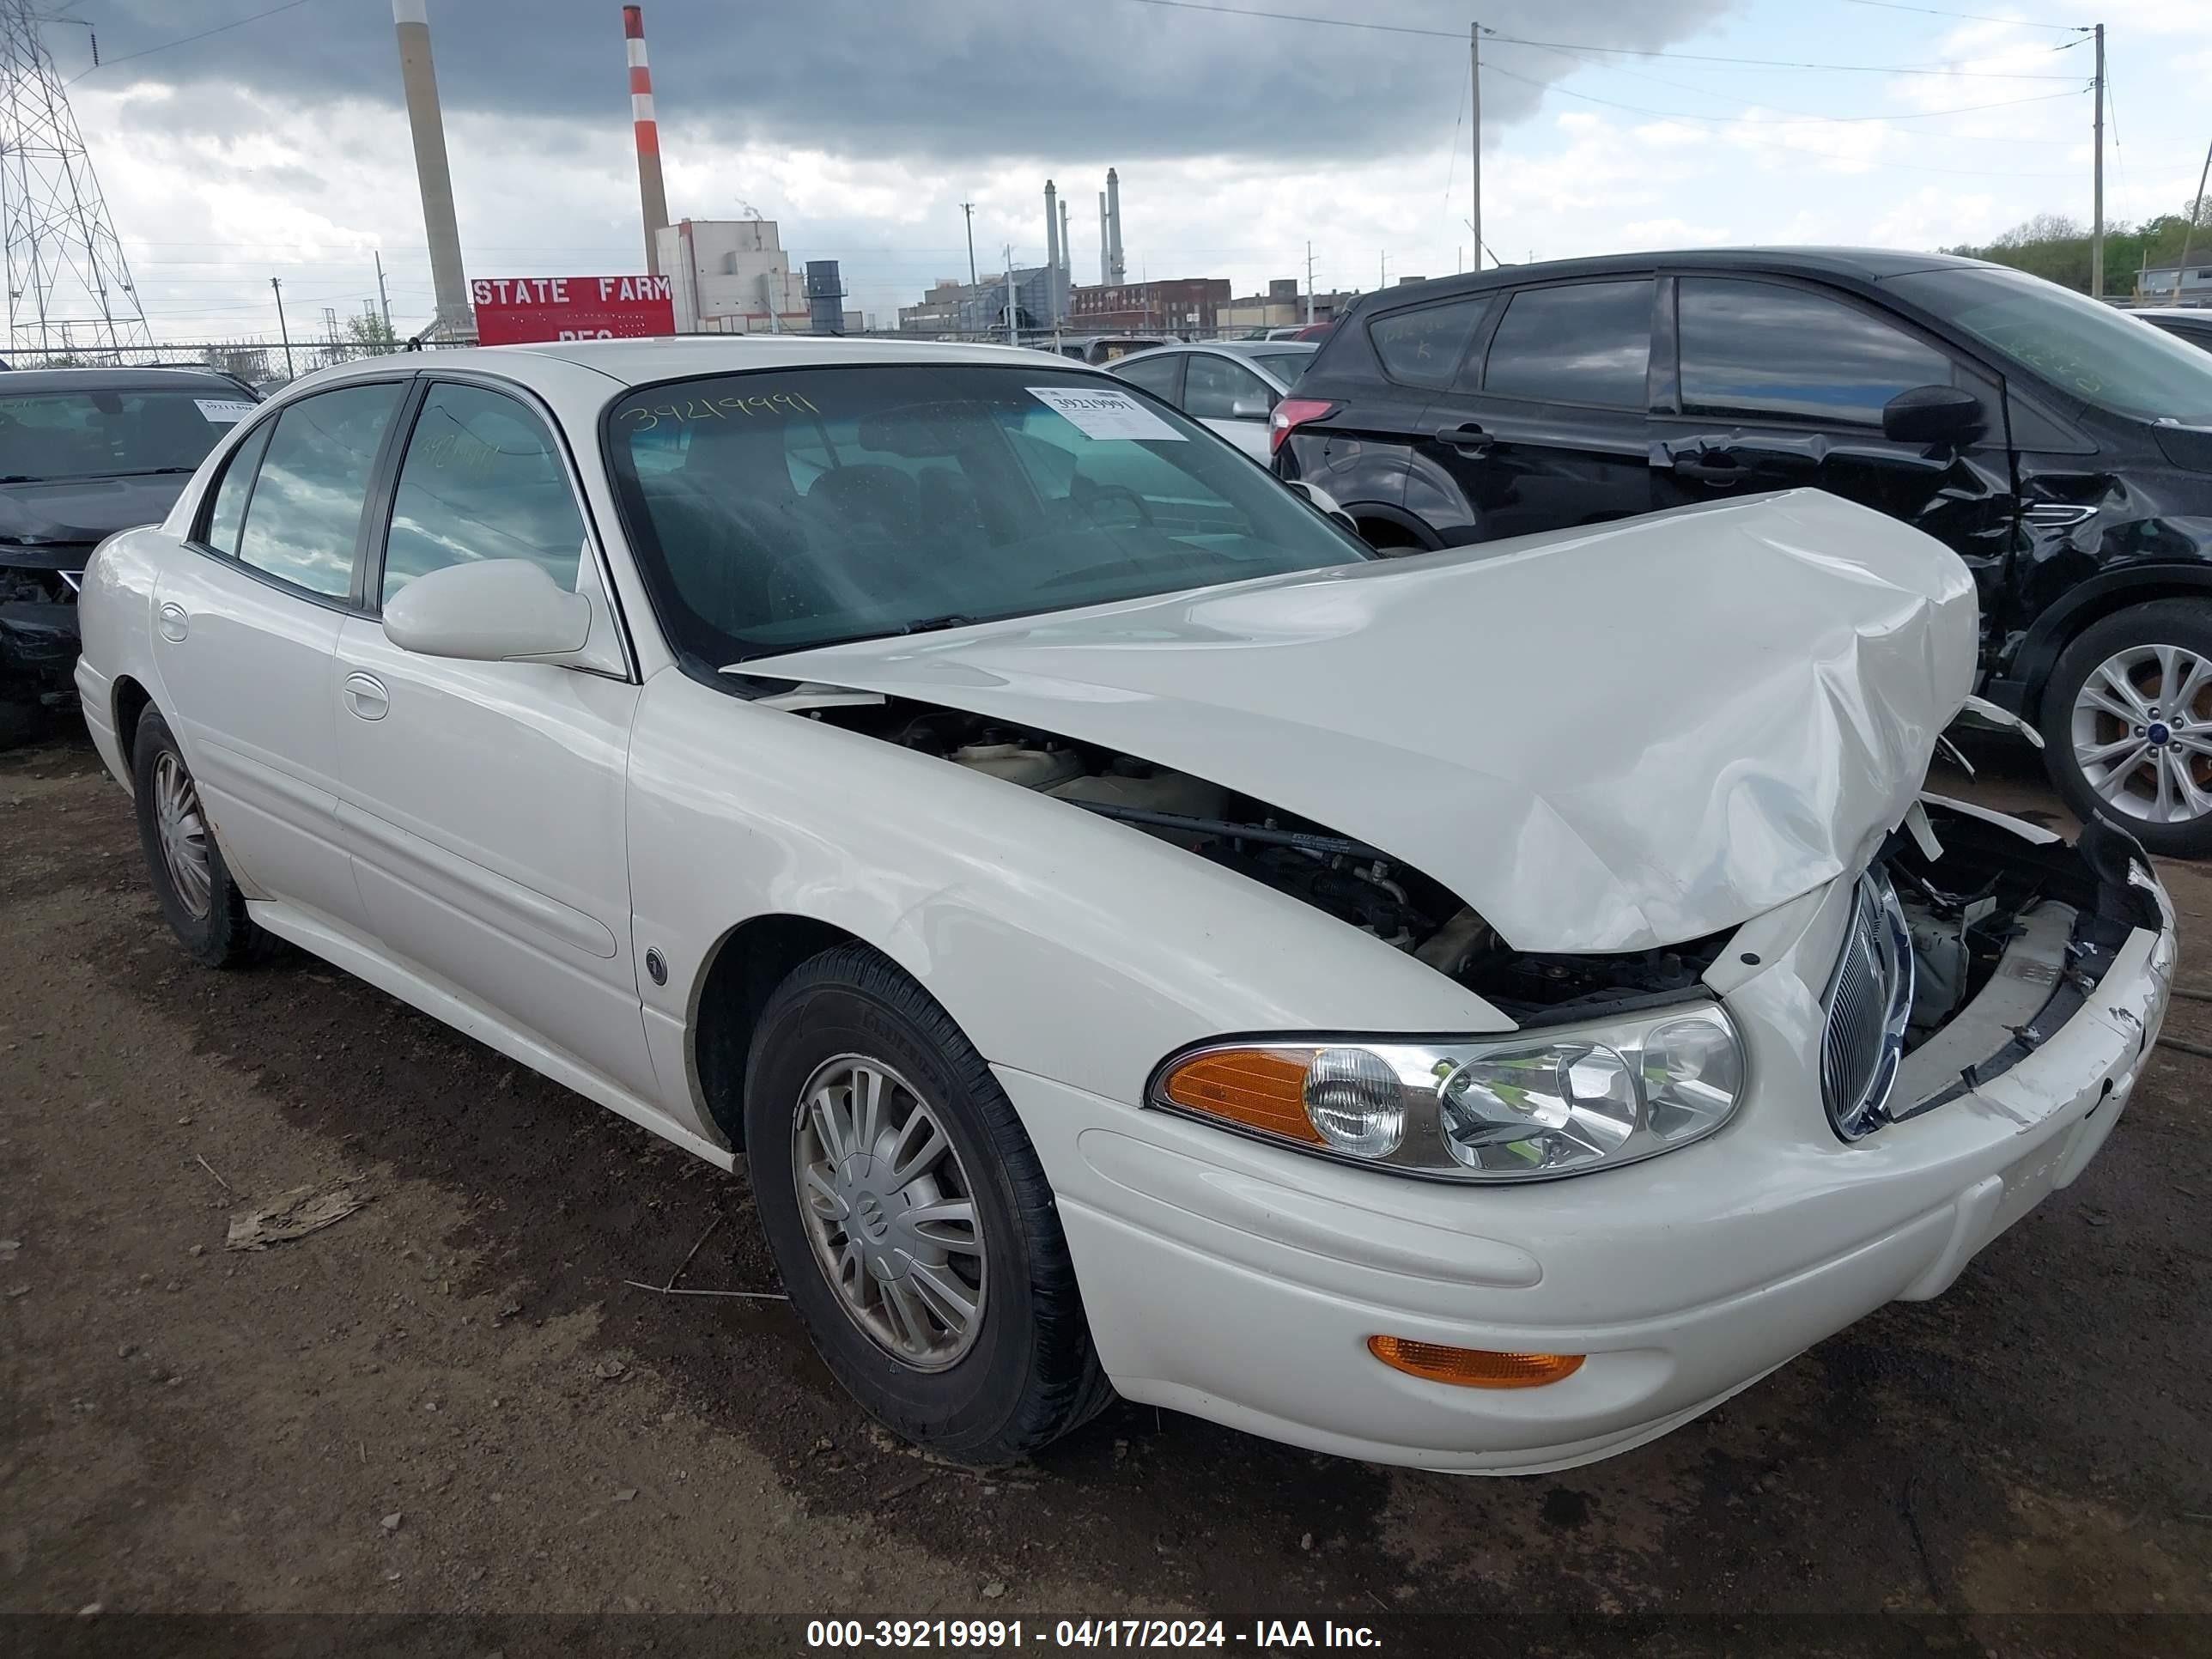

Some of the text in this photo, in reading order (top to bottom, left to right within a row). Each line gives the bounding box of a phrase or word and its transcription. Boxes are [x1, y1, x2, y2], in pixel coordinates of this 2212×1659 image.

[474, 276, 672, 305] STATE FARM
[619, 392, 819, 431] 39219991
[1053, 398, 1134, 410] 39219991
